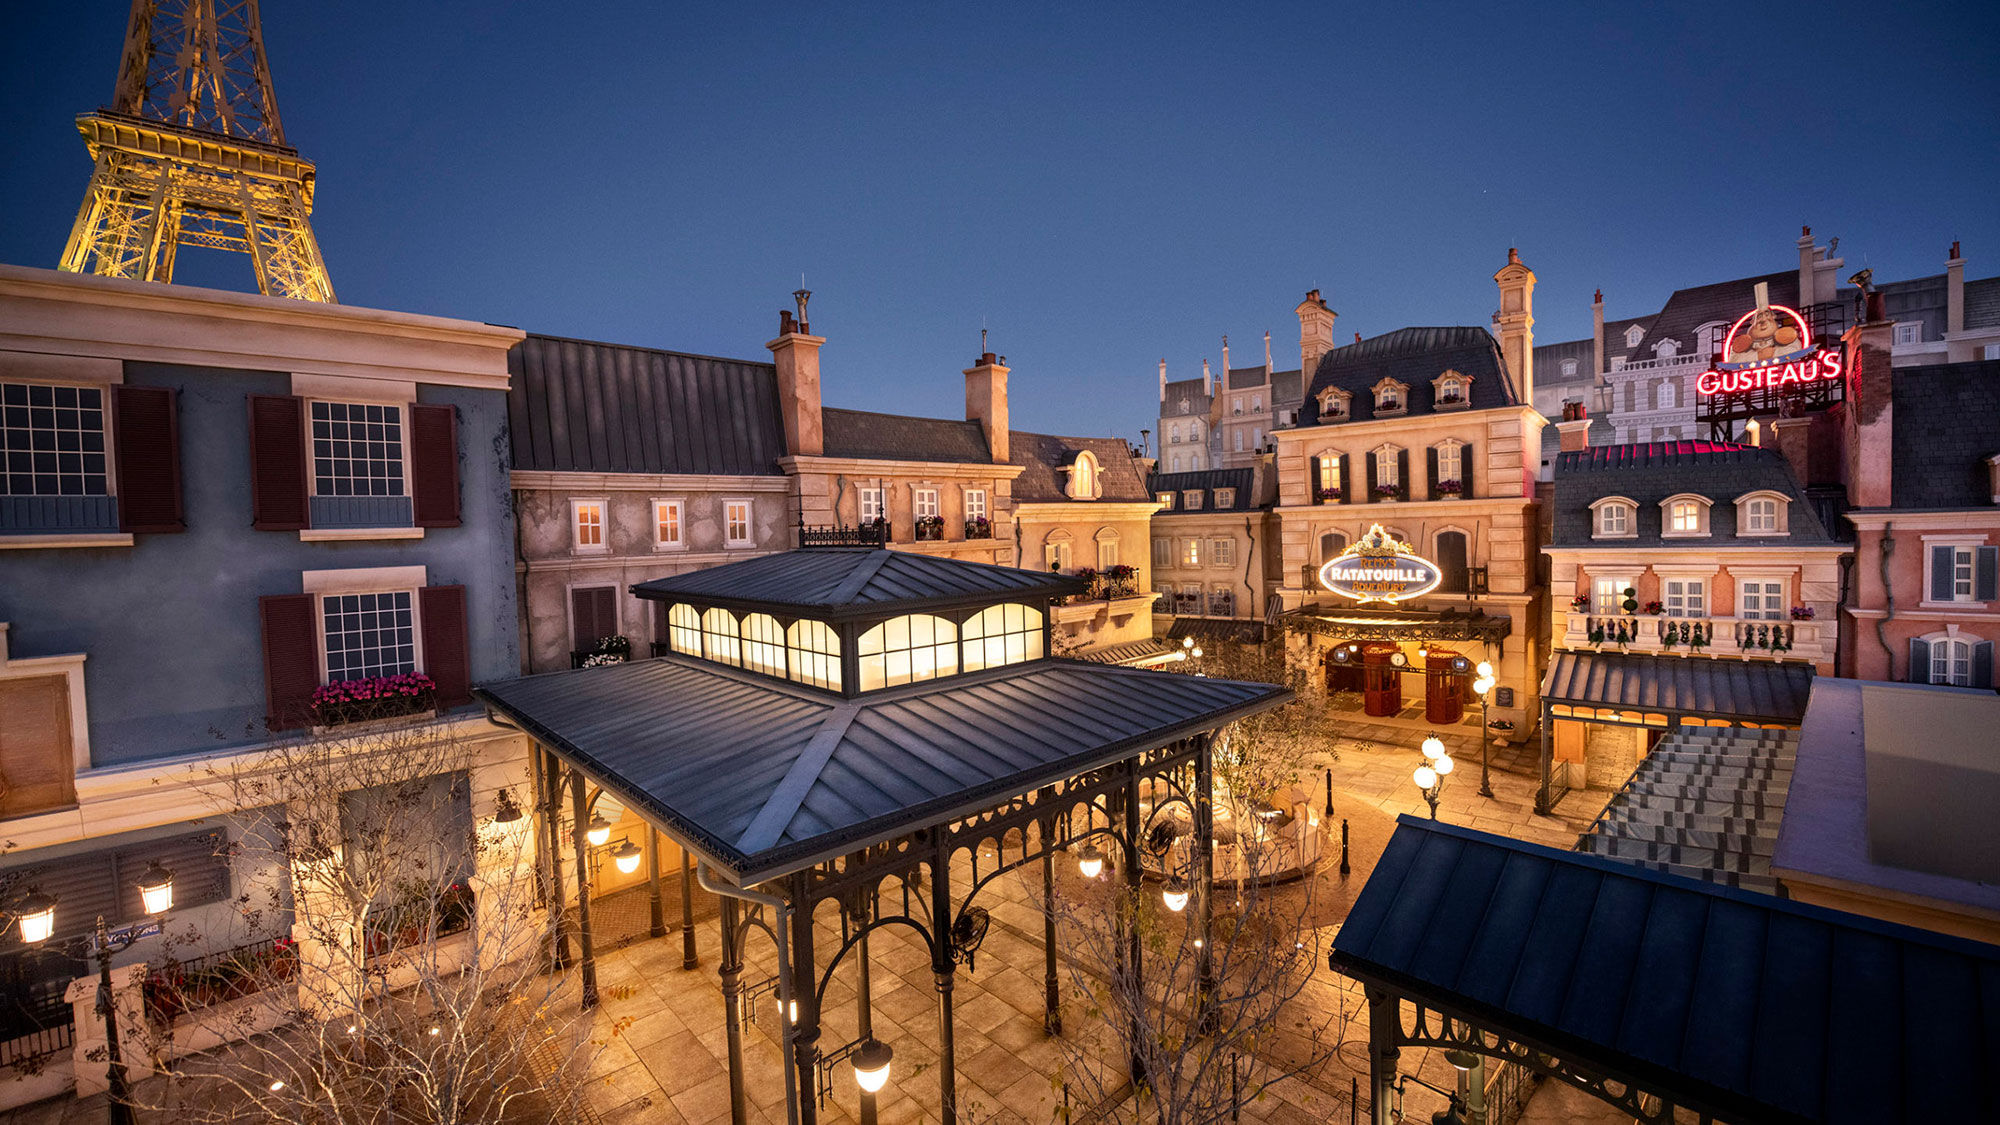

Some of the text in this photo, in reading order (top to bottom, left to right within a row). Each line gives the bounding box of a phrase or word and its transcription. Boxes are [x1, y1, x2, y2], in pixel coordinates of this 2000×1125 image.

[1697, 350, 1841, 395] GUSTEAU'S
[1331, 567, 1426, 582] RATATOUILLE
[1352, 581, 1407, 592] ADVENTURE
